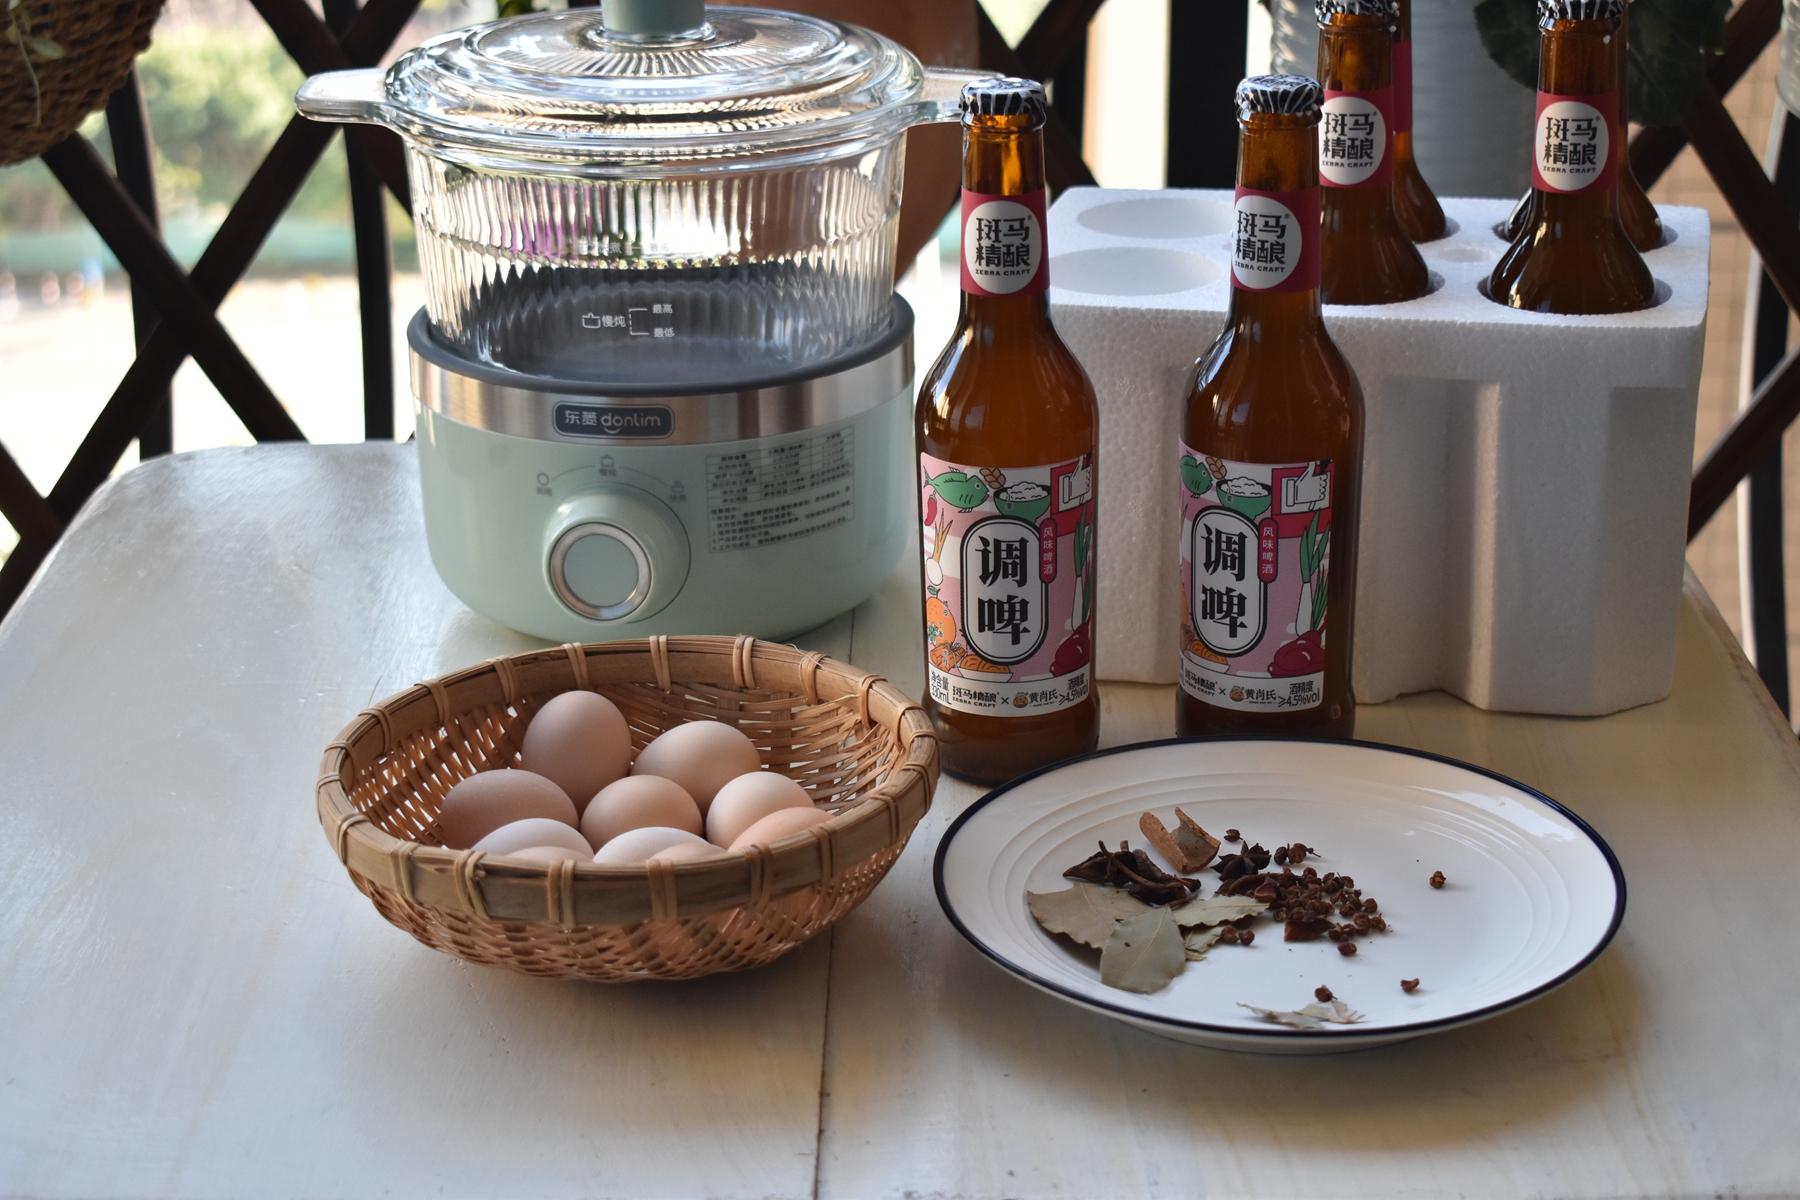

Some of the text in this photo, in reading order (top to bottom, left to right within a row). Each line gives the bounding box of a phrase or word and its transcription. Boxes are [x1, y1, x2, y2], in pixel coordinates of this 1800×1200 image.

[1324, 112, 1375, 136] 斑马
[1545, 116, 1597, 141] 斑马
[1321, 136, 1374, 160] 精酿
[1542, 141, 1597, 166] 精酿
[1321, 160, 1345, 168] ZEBRA
[1543, 165, 1567, 174] ZEBRA
[975, 217, 1030, 243] 斑马
[1237, 210, 1287, 239] 斑马
[974, 243, 1031, 268] 精酿
[1234, 235, 1286, 265] 精酿
[975, 268, 1031, 277] ZEBRA CRAFT
[1234, 260, 1286, 273] ZEBRA CRAFT
[652, 303, 673, 314] 最高
[601, 314, 627, 328] 慢炖
[653, 327, 676, 338] 最低
[564, 409, 661, 427] 东菱 donlim
[1042, 527, 1055, 576] 风味啤酒
[1262, 527, 1274, 575] 风味啤酒
[1200, 523, 1248, 639] 调啤
[975, 536, 1031, 646] 调啤
[1067, 673, 1085, 690] 酒精度
[1289, 680, 1315, 696] 酒精度
[952, 685, 997, 704] 斑马精酿
[1197, 686, 1215, 697] CRAFT
[951, 697, 997, 709] ZEBRA CRAFT
